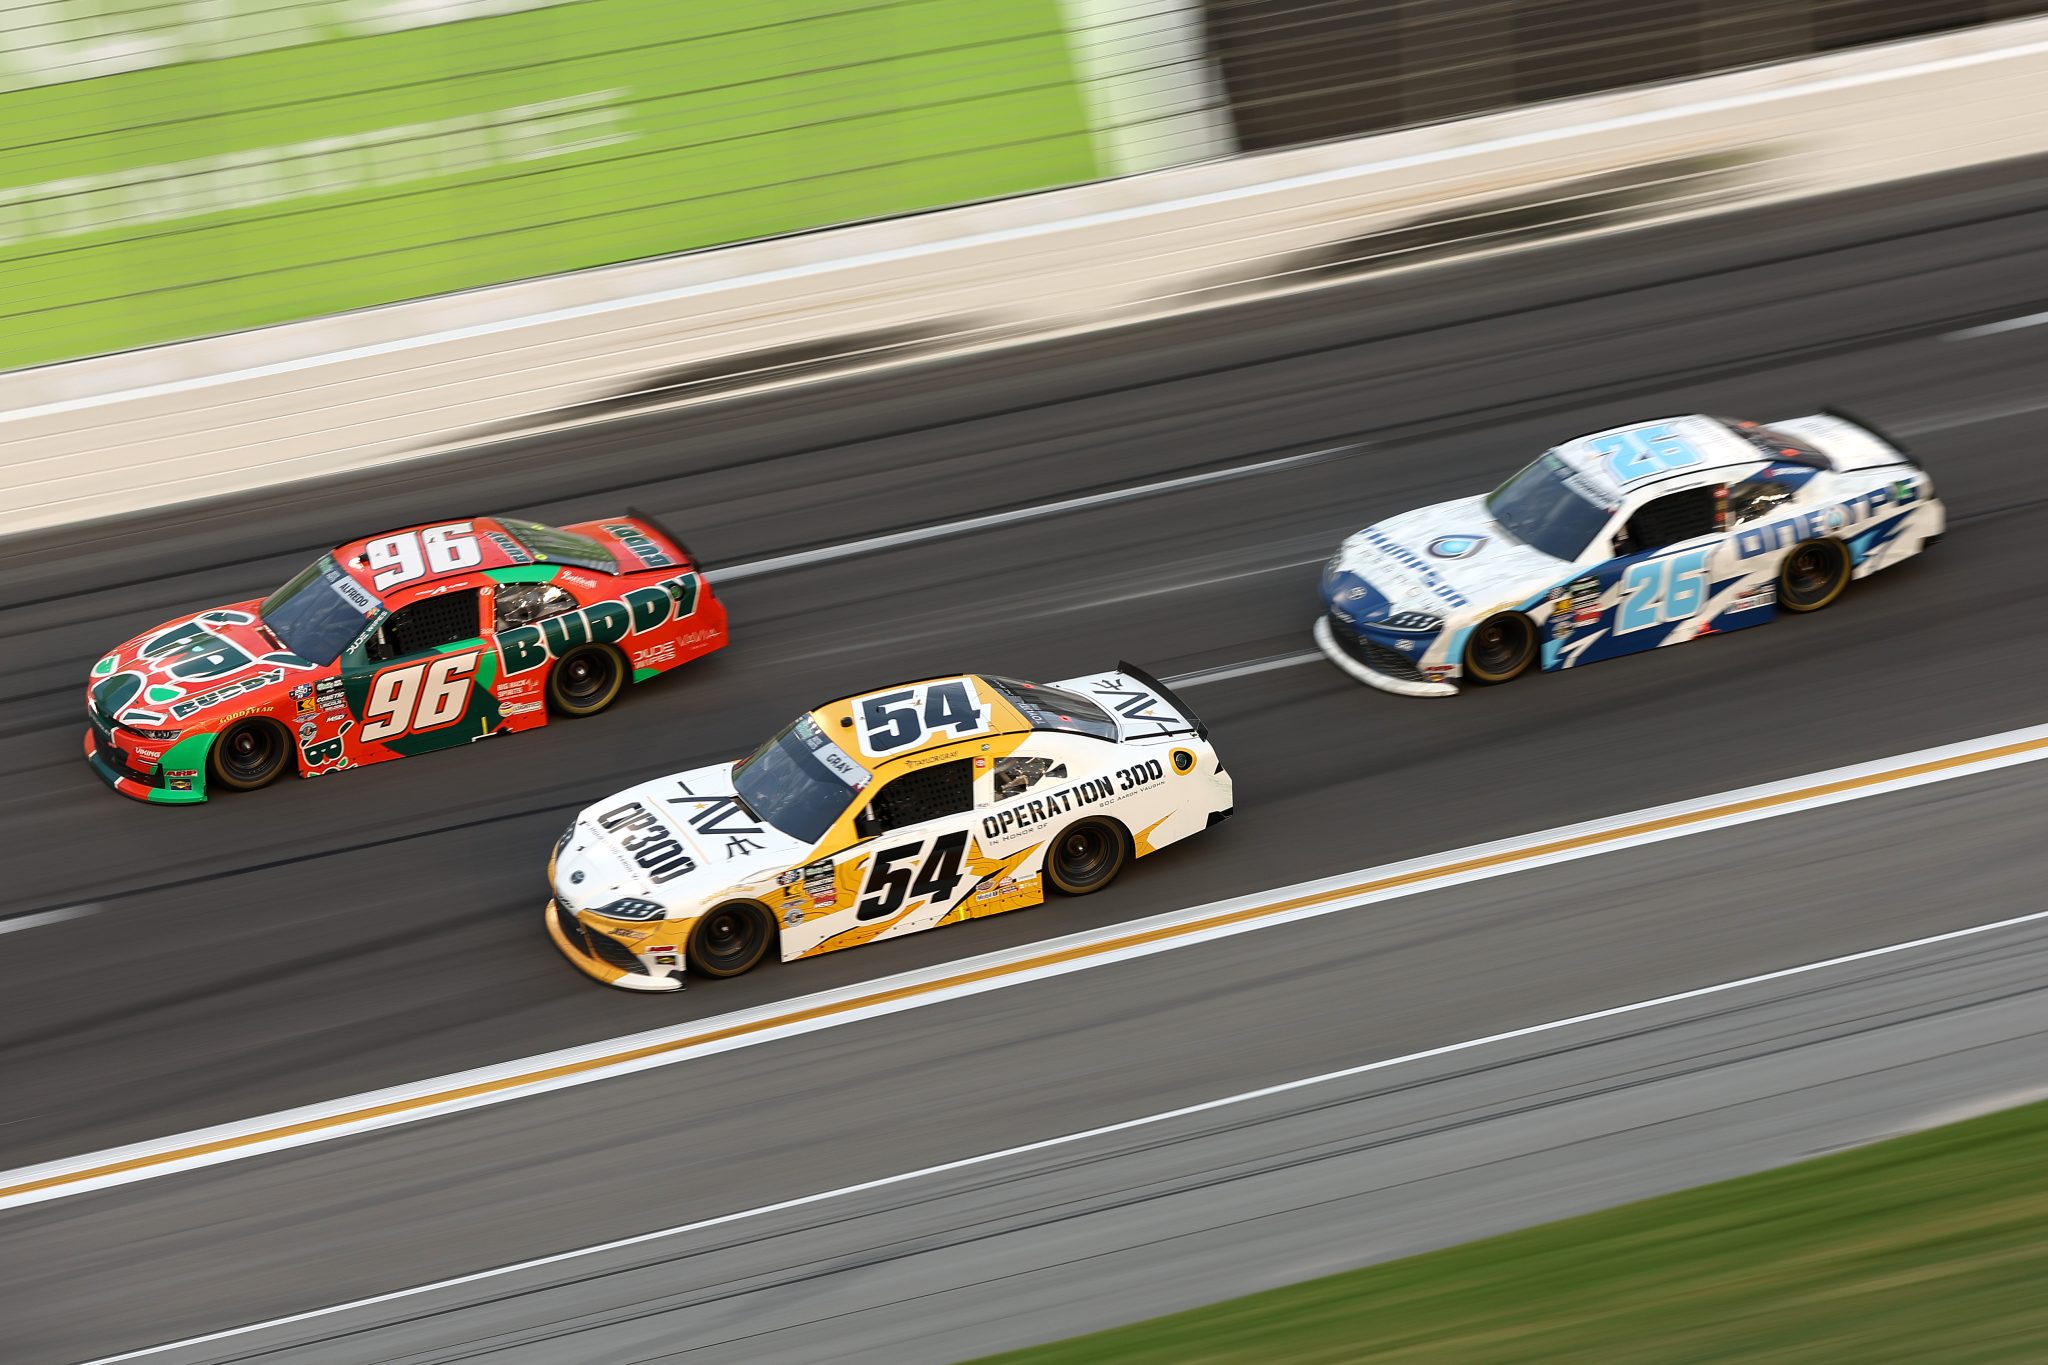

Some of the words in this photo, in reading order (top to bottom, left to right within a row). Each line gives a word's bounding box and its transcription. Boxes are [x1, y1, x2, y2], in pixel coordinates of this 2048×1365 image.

[1590, 424, 1703, 483] 26
[366, 521, 482, 592] 96
[339, 582, 369, 608] ALFREDO
[1614, 547, 1713, 636] 26
[345, 631, 369, 655] DUDE
[366, 610, 389, 632] WIPES
[492, 571, 702, 678] BUDDY
[632, 640, 676, 662] DUDE
[168, 667, 286, 722] BUDDY
[218, 706, 275, 726] GOODYEAR
[359, 650, 481, 743] 96
[862, 681, 982, 752] 54
[135, 746, 162, 758] VIKING
[165, 769, 198, 778] ARP
[826, 753, 854, 774] GRAY
[982, 775, 1116, 839] OPERATION
[1115, 758, 1164, 792] 300
[1117, 790, 1139, 801] AARON
[1140, 780, 1166, 792] VAUGHN
[597, 801, 697, 885] OP300
[1002, 828, 1034, 842] HONOR
[1036, 822, 1049, 830] OF
[856, 829, 970, 921] 54
